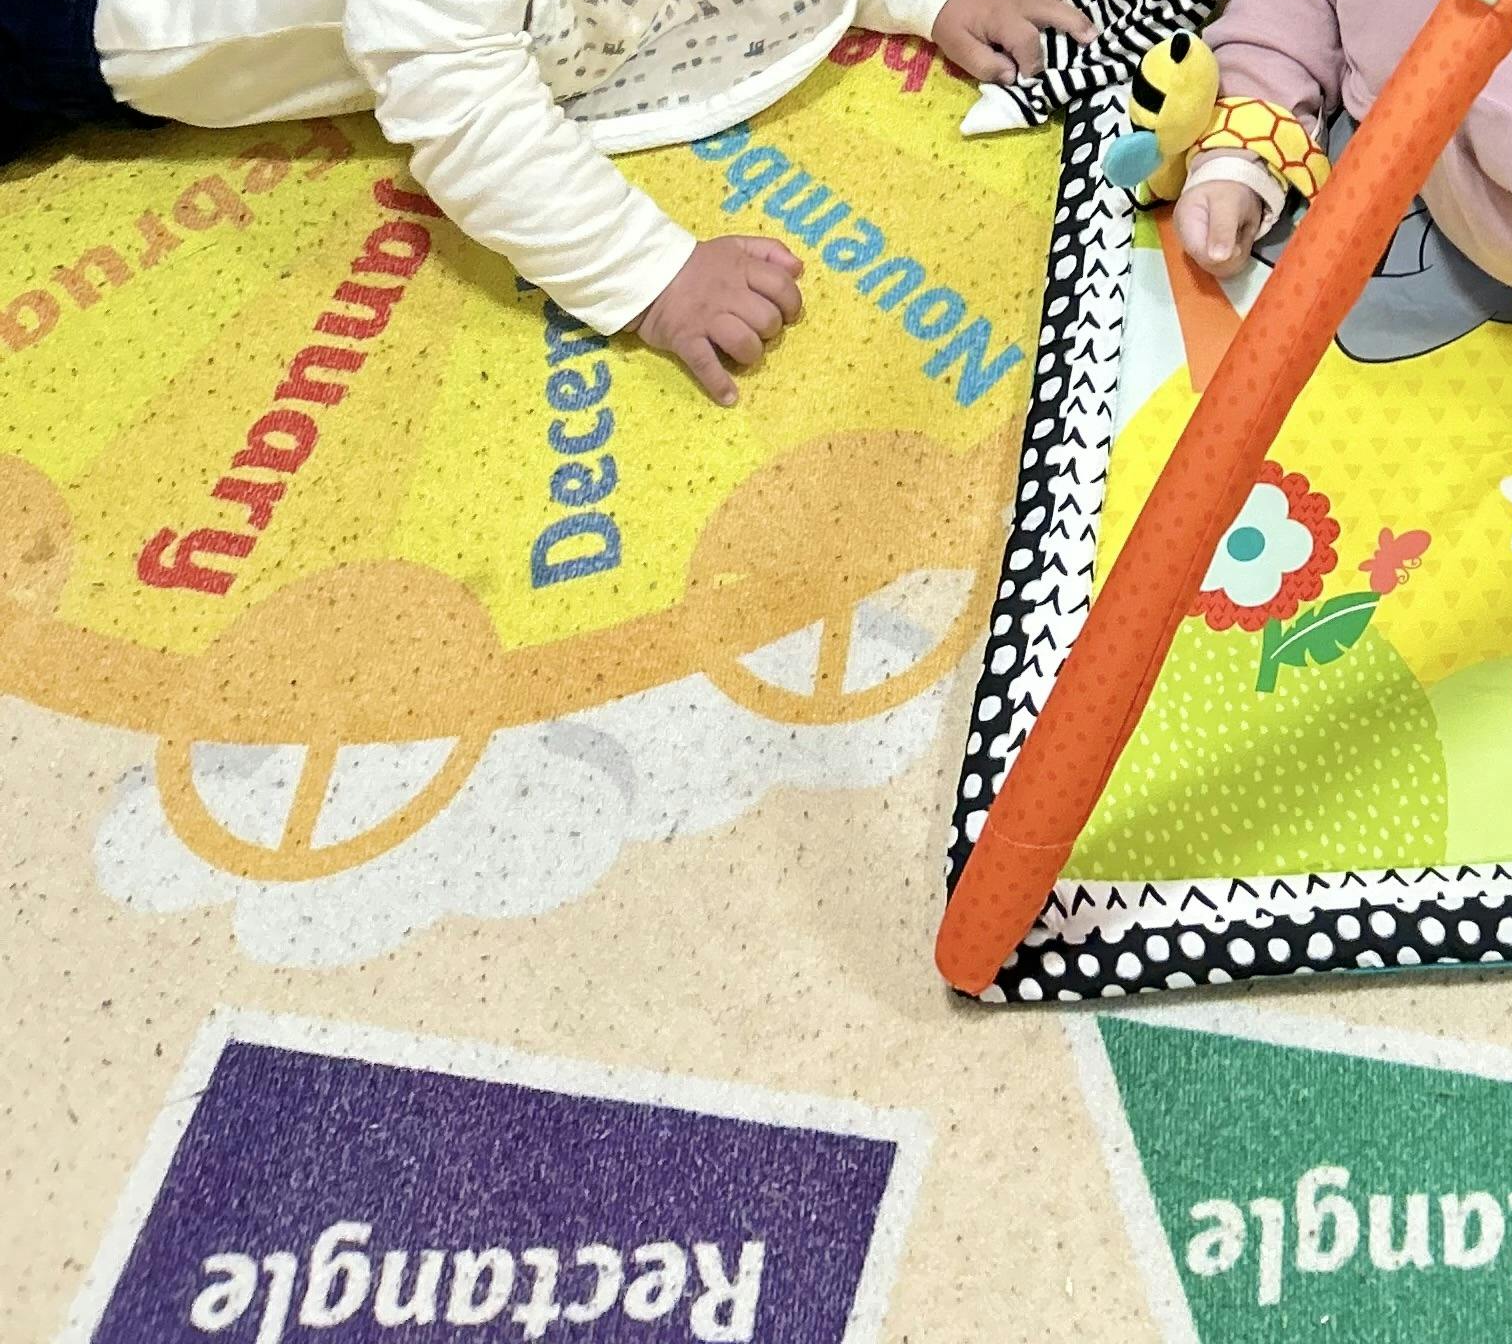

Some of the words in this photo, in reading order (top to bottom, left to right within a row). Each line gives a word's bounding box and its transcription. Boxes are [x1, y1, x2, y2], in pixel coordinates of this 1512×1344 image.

[0, 119, 353, 353] Februa
[690, 120, 1026, 410] Novembe
[136, 177, 451, 598] January
[514, 276, 622, 590] Decem
[189, 1220, 766, 1344] Rectangle
